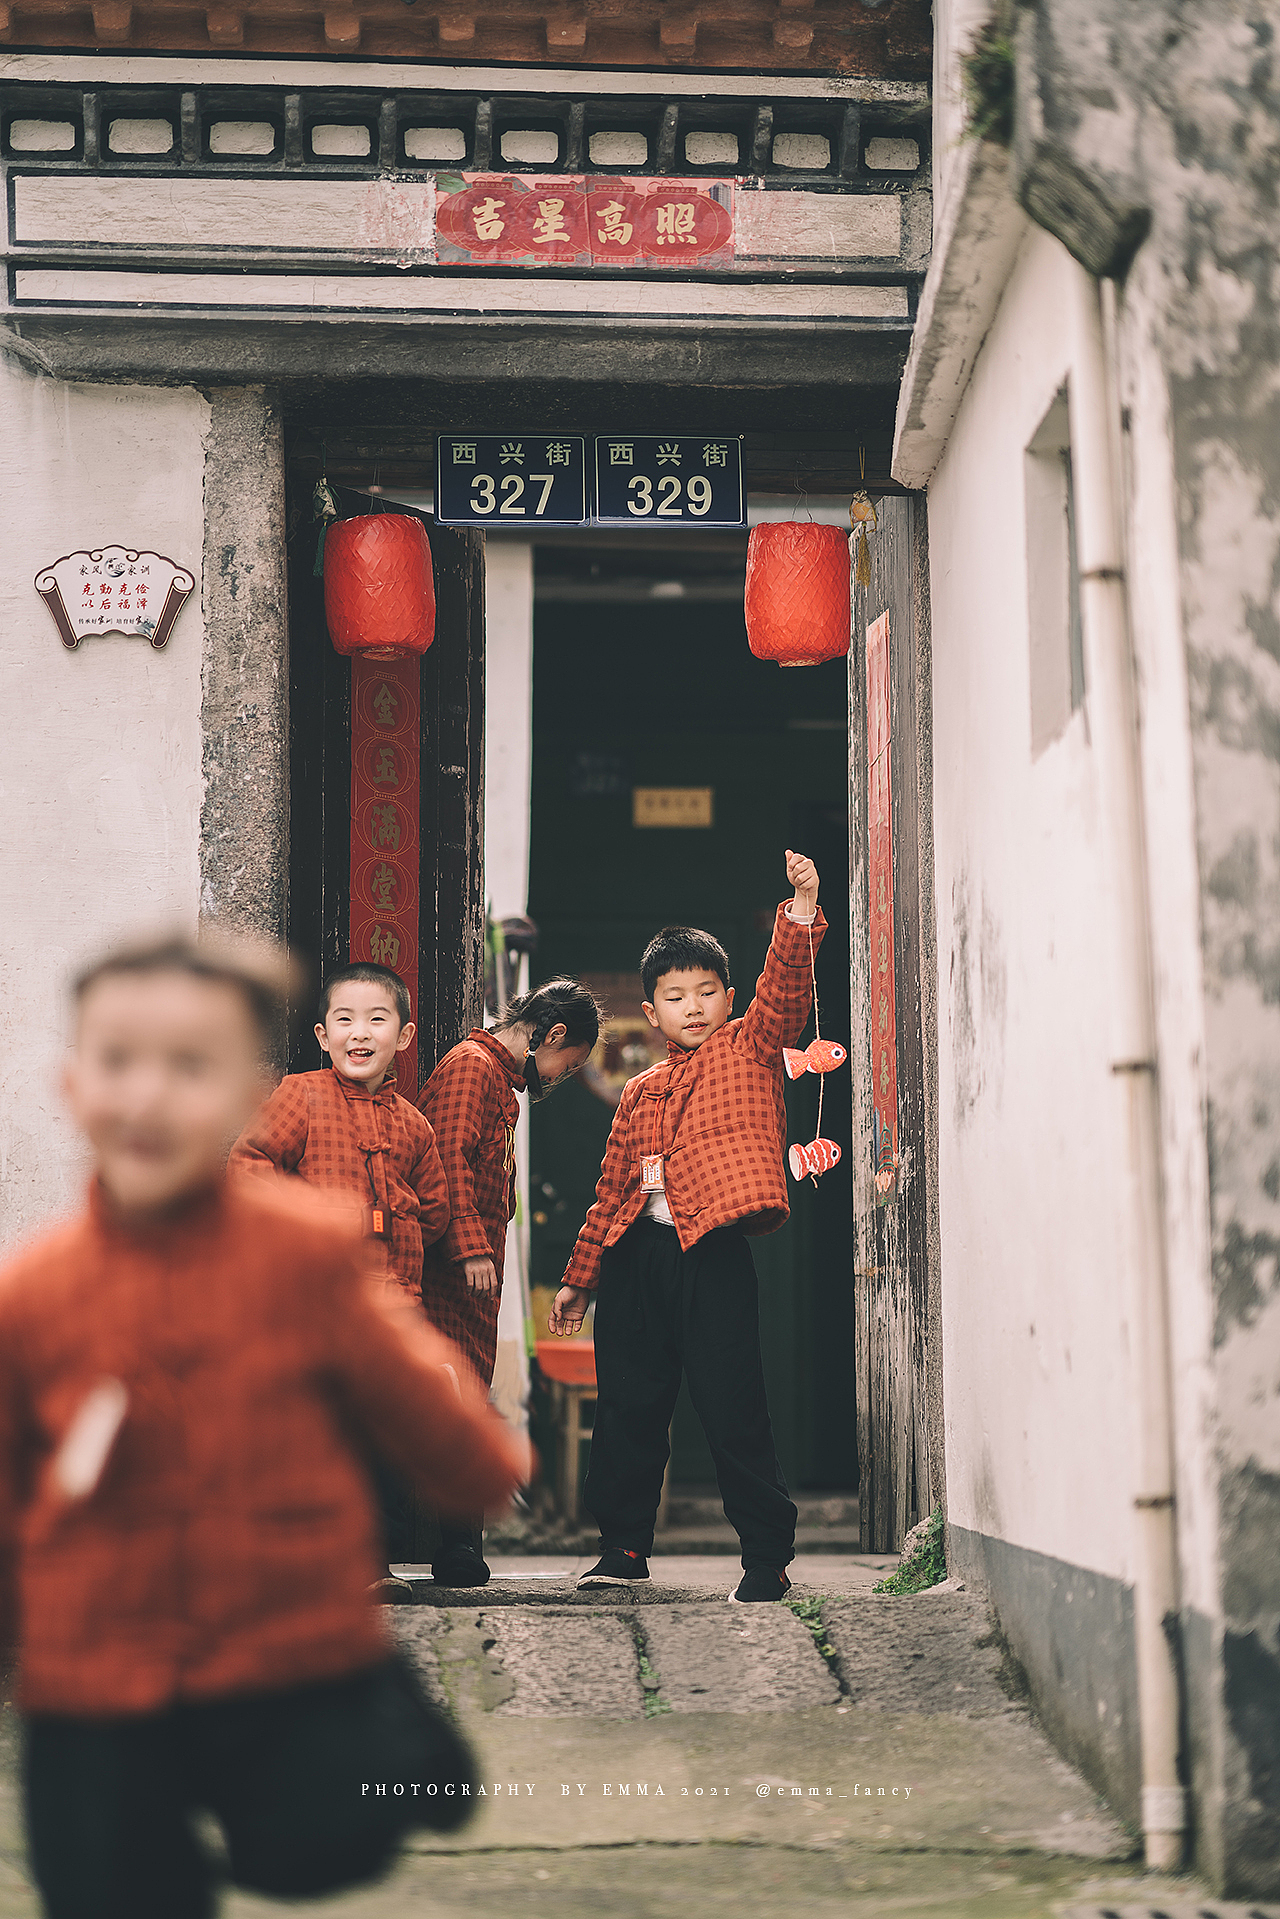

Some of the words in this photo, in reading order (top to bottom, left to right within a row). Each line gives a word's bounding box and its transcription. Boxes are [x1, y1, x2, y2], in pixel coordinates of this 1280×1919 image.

[471, 196, 698, 246] 吉星高照
[451, 442, 572, 467] 西兴街
[608, 442, 729, 468] 西兴街
[469, 474, 556, 516] 327
[626, 475, 713, 517] 329
[78, 564, 103, 577] 家风
[127, 564, 151, 577] 家训
[81, 582, 150, 597] 克勤克俭
[81, 598, 149, 611] 以后福泽
[369, 683, 401, 1092] 金玉满堂纳
